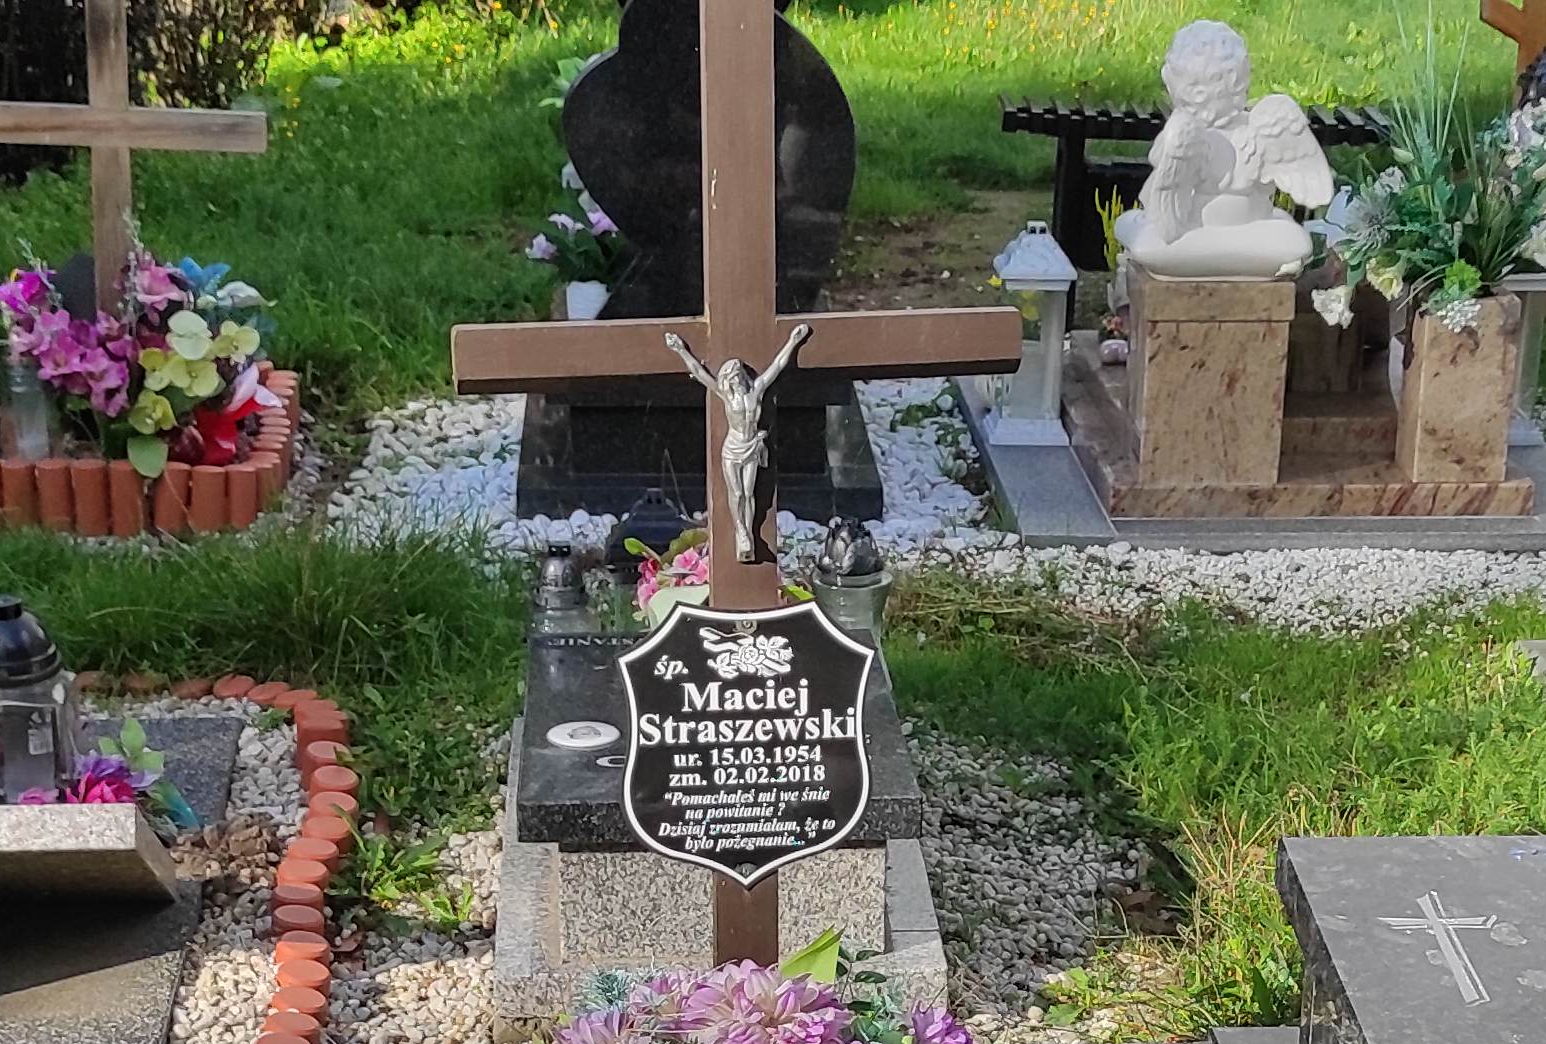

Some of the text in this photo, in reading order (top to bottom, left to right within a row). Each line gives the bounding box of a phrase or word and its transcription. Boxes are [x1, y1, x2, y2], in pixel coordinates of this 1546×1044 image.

[653, 655, 689, 679] śp.
[680, 678, 809, 716] Maciej
[639, 707, 857, 745] Straszewski
[673, 744, 822, 767] ur. 15.03.1954
[669, 765, 826, 787] zm. 02.02.2018
[758, 787, 777, 802] mi
[685, 808, 704, 820] na
[658, 821, 707, 838] Dzisiaj
[822, 818, 836, 830] to
